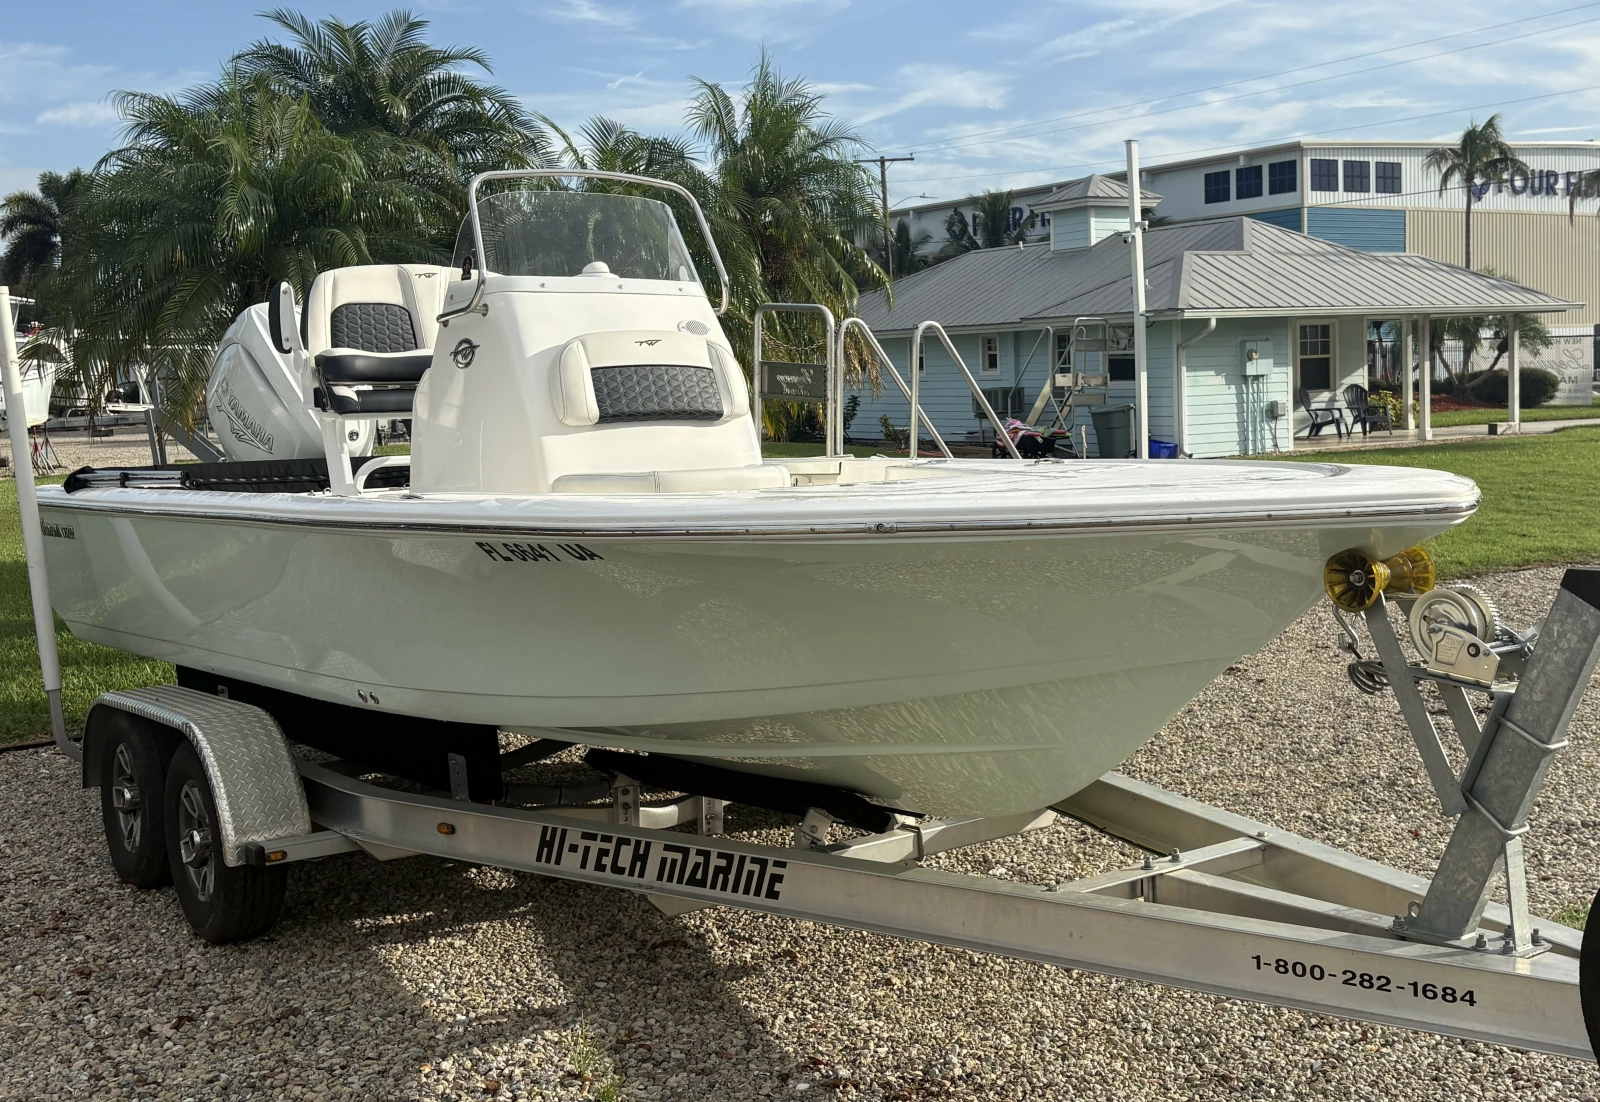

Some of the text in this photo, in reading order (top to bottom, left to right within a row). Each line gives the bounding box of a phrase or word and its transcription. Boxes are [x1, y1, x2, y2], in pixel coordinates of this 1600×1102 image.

[1498, 168, 1558, 196] OUR
[228, 389, 275, 451] YAMAHA
[556, 543, 605, 561] UA
[535, 825, 787, 900] HI-TECH MARINE
[1251, 954, 1477, 1007] 1-800-282-1684
